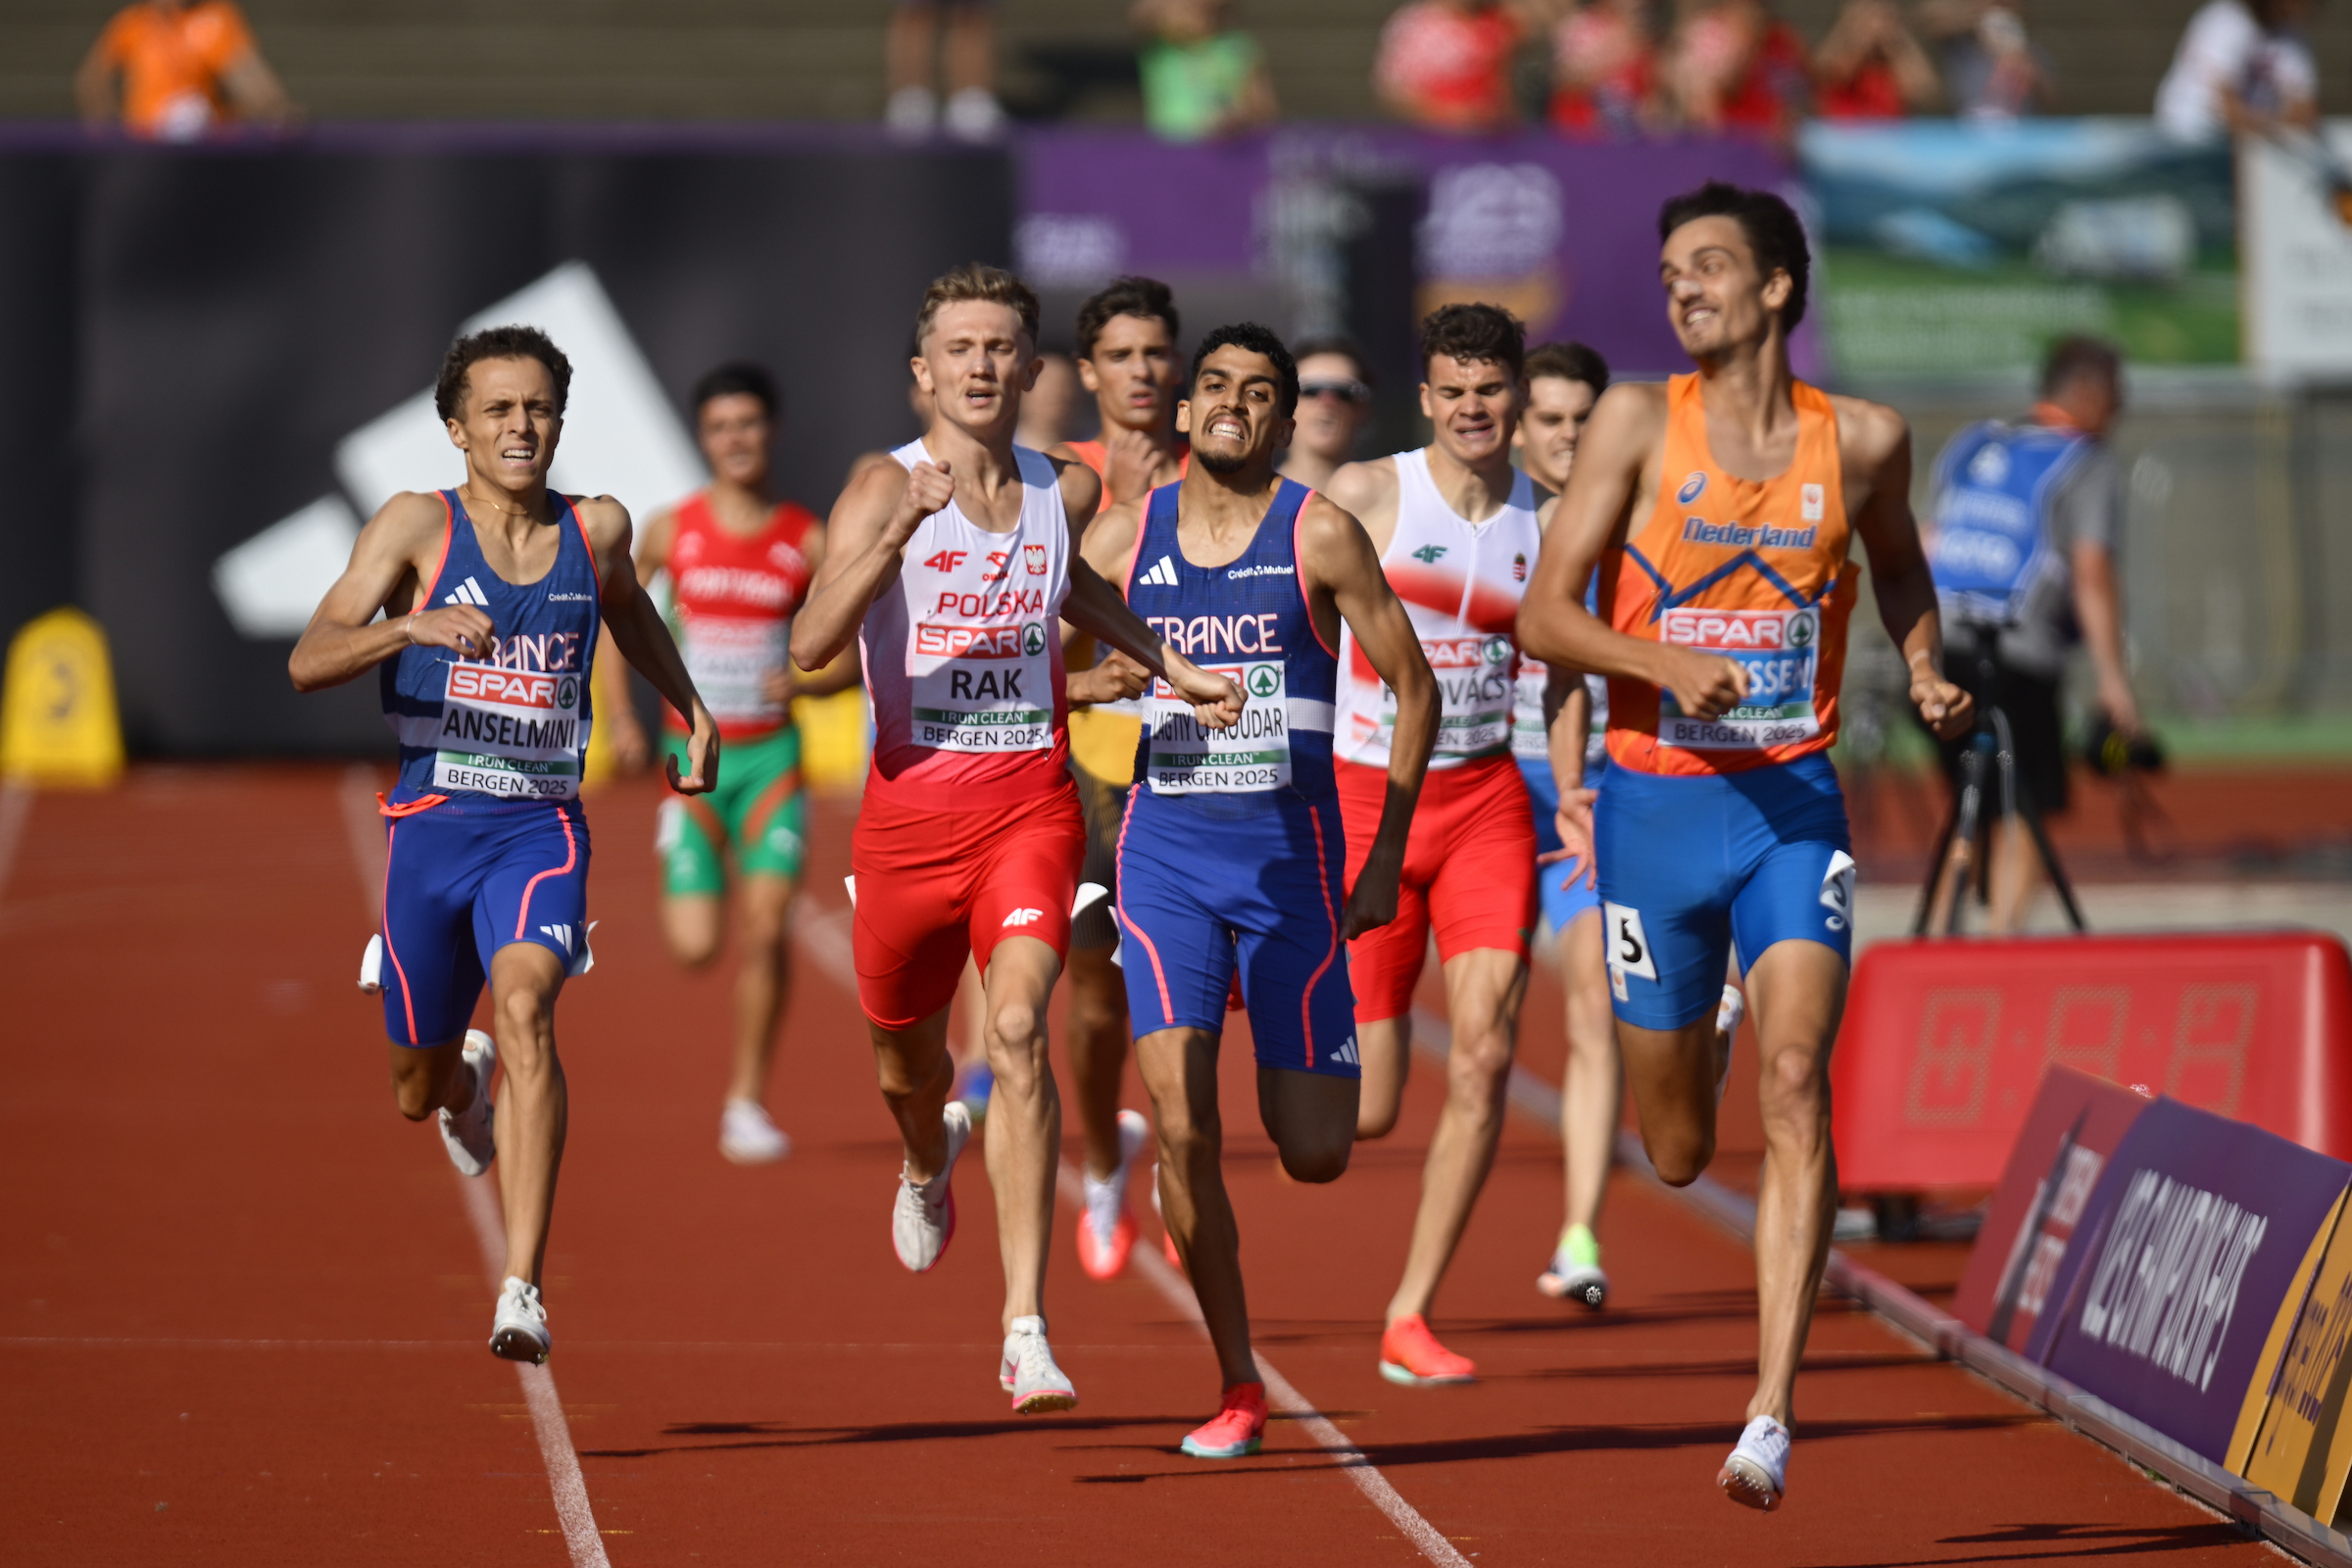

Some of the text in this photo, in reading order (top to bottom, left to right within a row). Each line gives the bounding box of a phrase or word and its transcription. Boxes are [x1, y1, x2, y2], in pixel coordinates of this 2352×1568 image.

[1228, 564, 1294, 579] Crédit Mutuel
[938, 589, 1044, 617] POLSKA
[919, 627, 1019, 655] SPAR
[1669, 616, 1782, 645] SPAR
[1420, 642, 1482, 665] PAR
[453, 670, 556, 704] SPAR
[951, 668, 1022, 700] RAK
[443, 709, 575, 749] ANSELMINI
[949, 711, 978, 724] RUN
[1152, 710, 1191, 741] LAGTIY
[923, 726, 1043, 746] BERGEN 2025
[1675, 723, 1806, 743] BERGEN 2025
[474, 756, 505, 769] RUN
[1177, 754, 1205, 765] RUN
[448, 769, 567, 795] BERGEN 2025
[1159, 768, 1278, 787] BERGEN 2025
